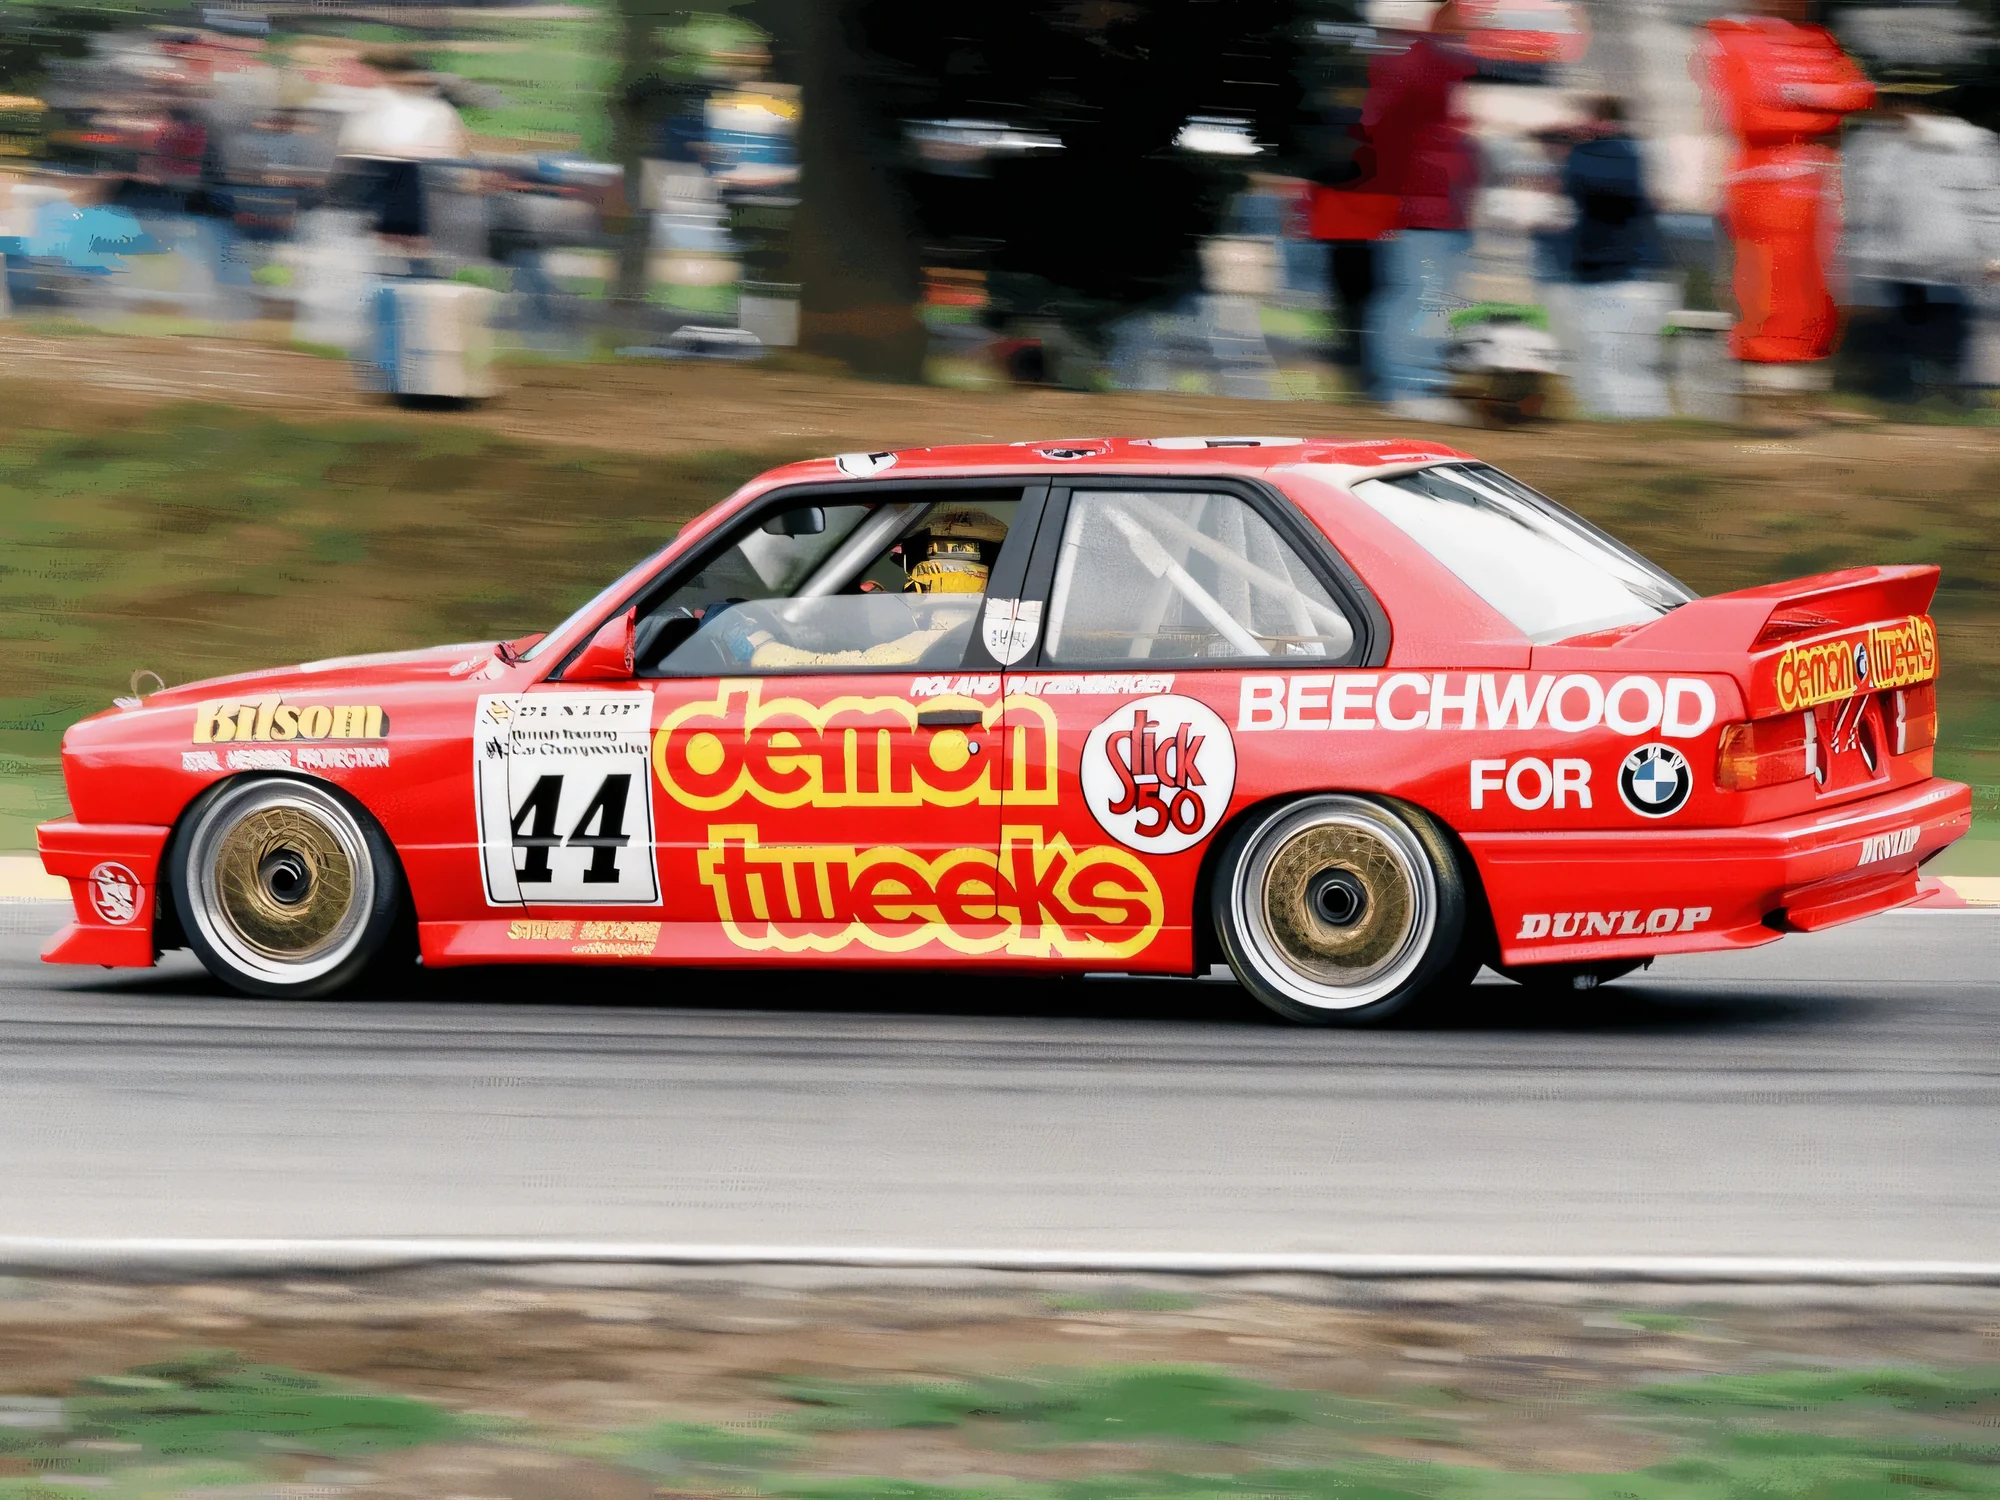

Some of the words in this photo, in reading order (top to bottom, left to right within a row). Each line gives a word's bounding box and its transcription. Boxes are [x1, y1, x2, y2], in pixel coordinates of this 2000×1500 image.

[192, 693, 390, 744] Bilsom
[1236, 673, 1716, 738] BEECHWOOD
[655, 679, 1058, 810] demon
[1134, 783, 1206, 838] 50
[1470, 757, 1593, 810] FOR
[511, 774, 631, 883] 44
[697, 823, 1165, 959] tweeks
[1515, 906, 1713, 940] DUNLOP
